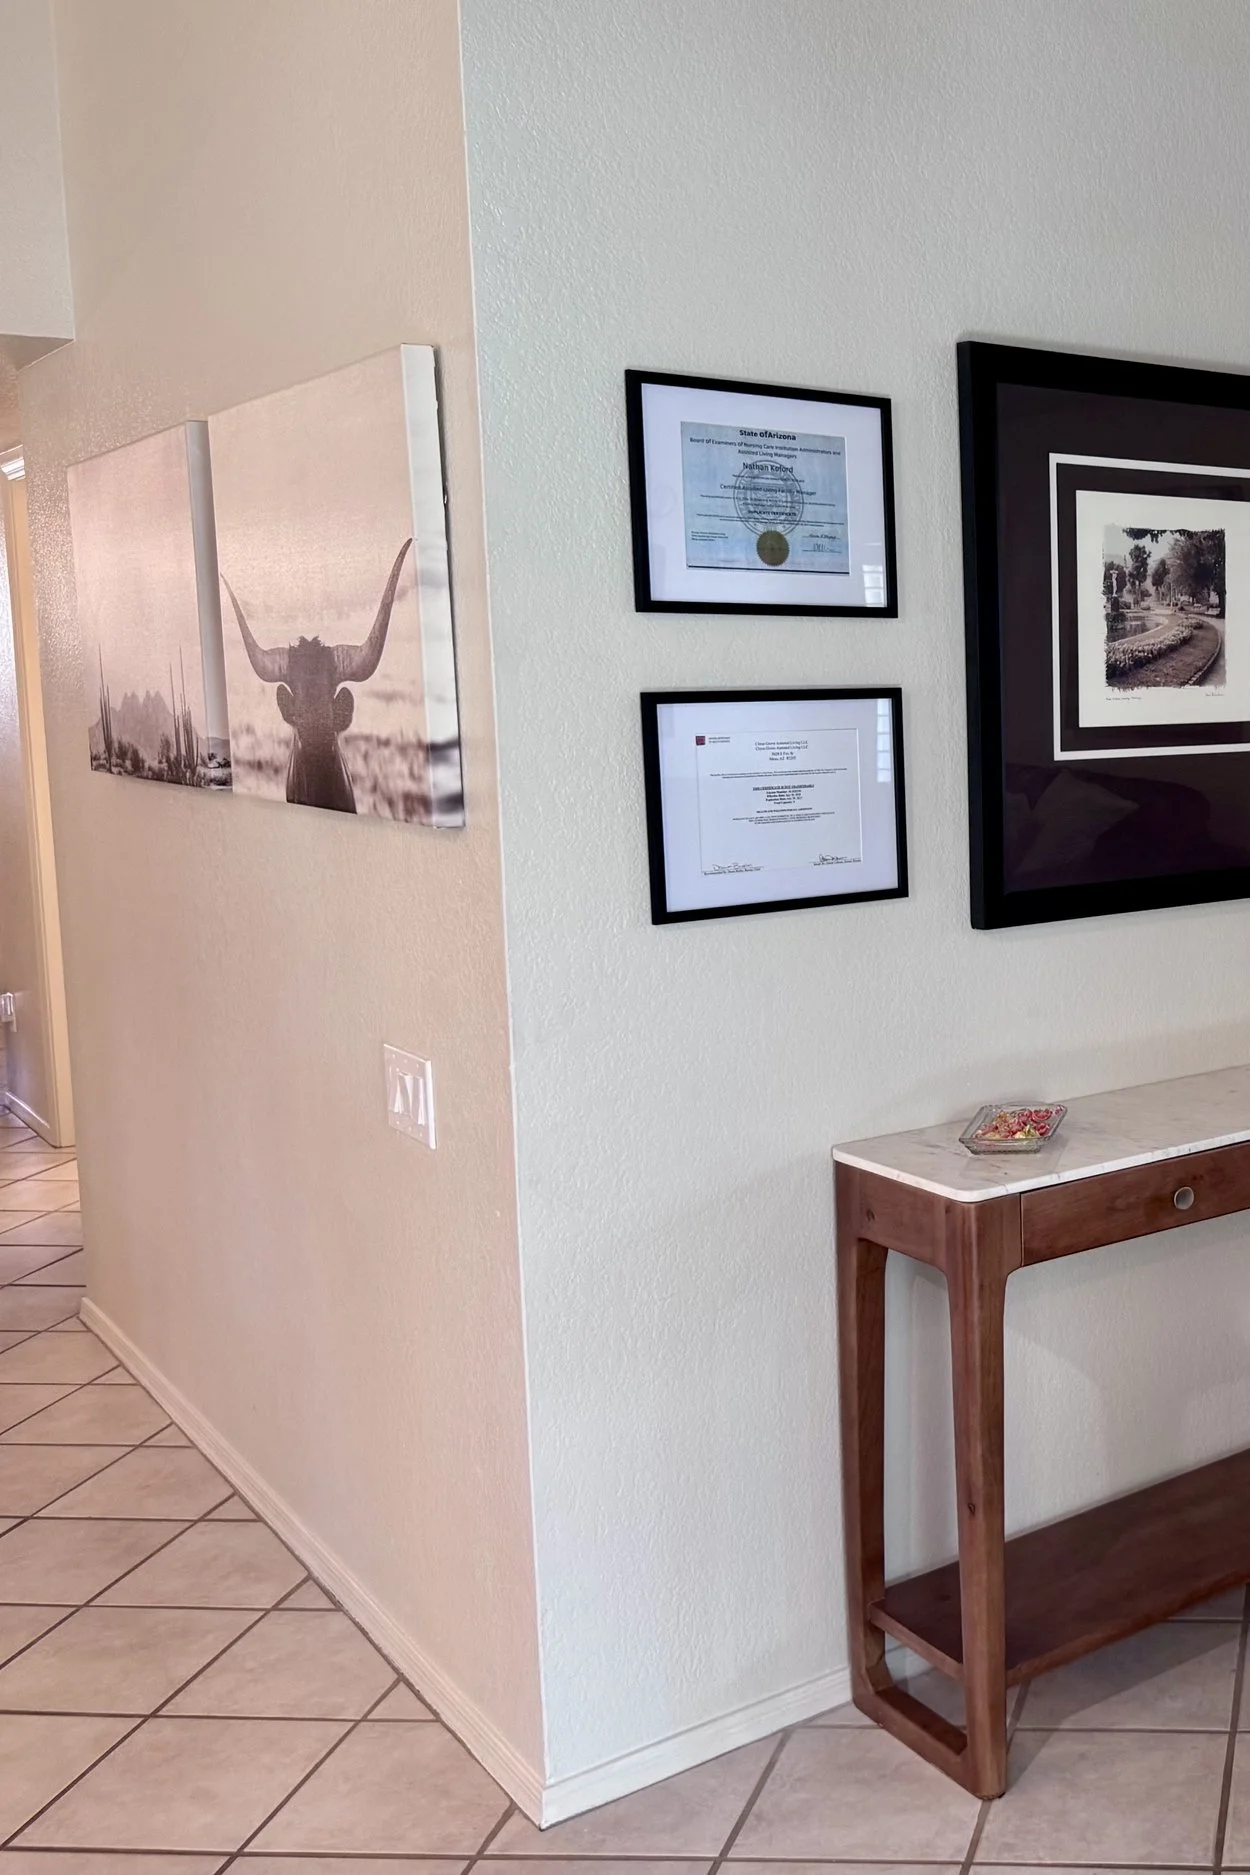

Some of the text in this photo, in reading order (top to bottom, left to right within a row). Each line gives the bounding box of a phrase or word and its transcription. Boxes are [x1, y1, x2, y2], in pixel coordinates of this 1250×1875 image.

[739, 429, 758, 437] State
[768, 431, 796, 440] Arizona
[743, 462, 769, 471] Nathan
